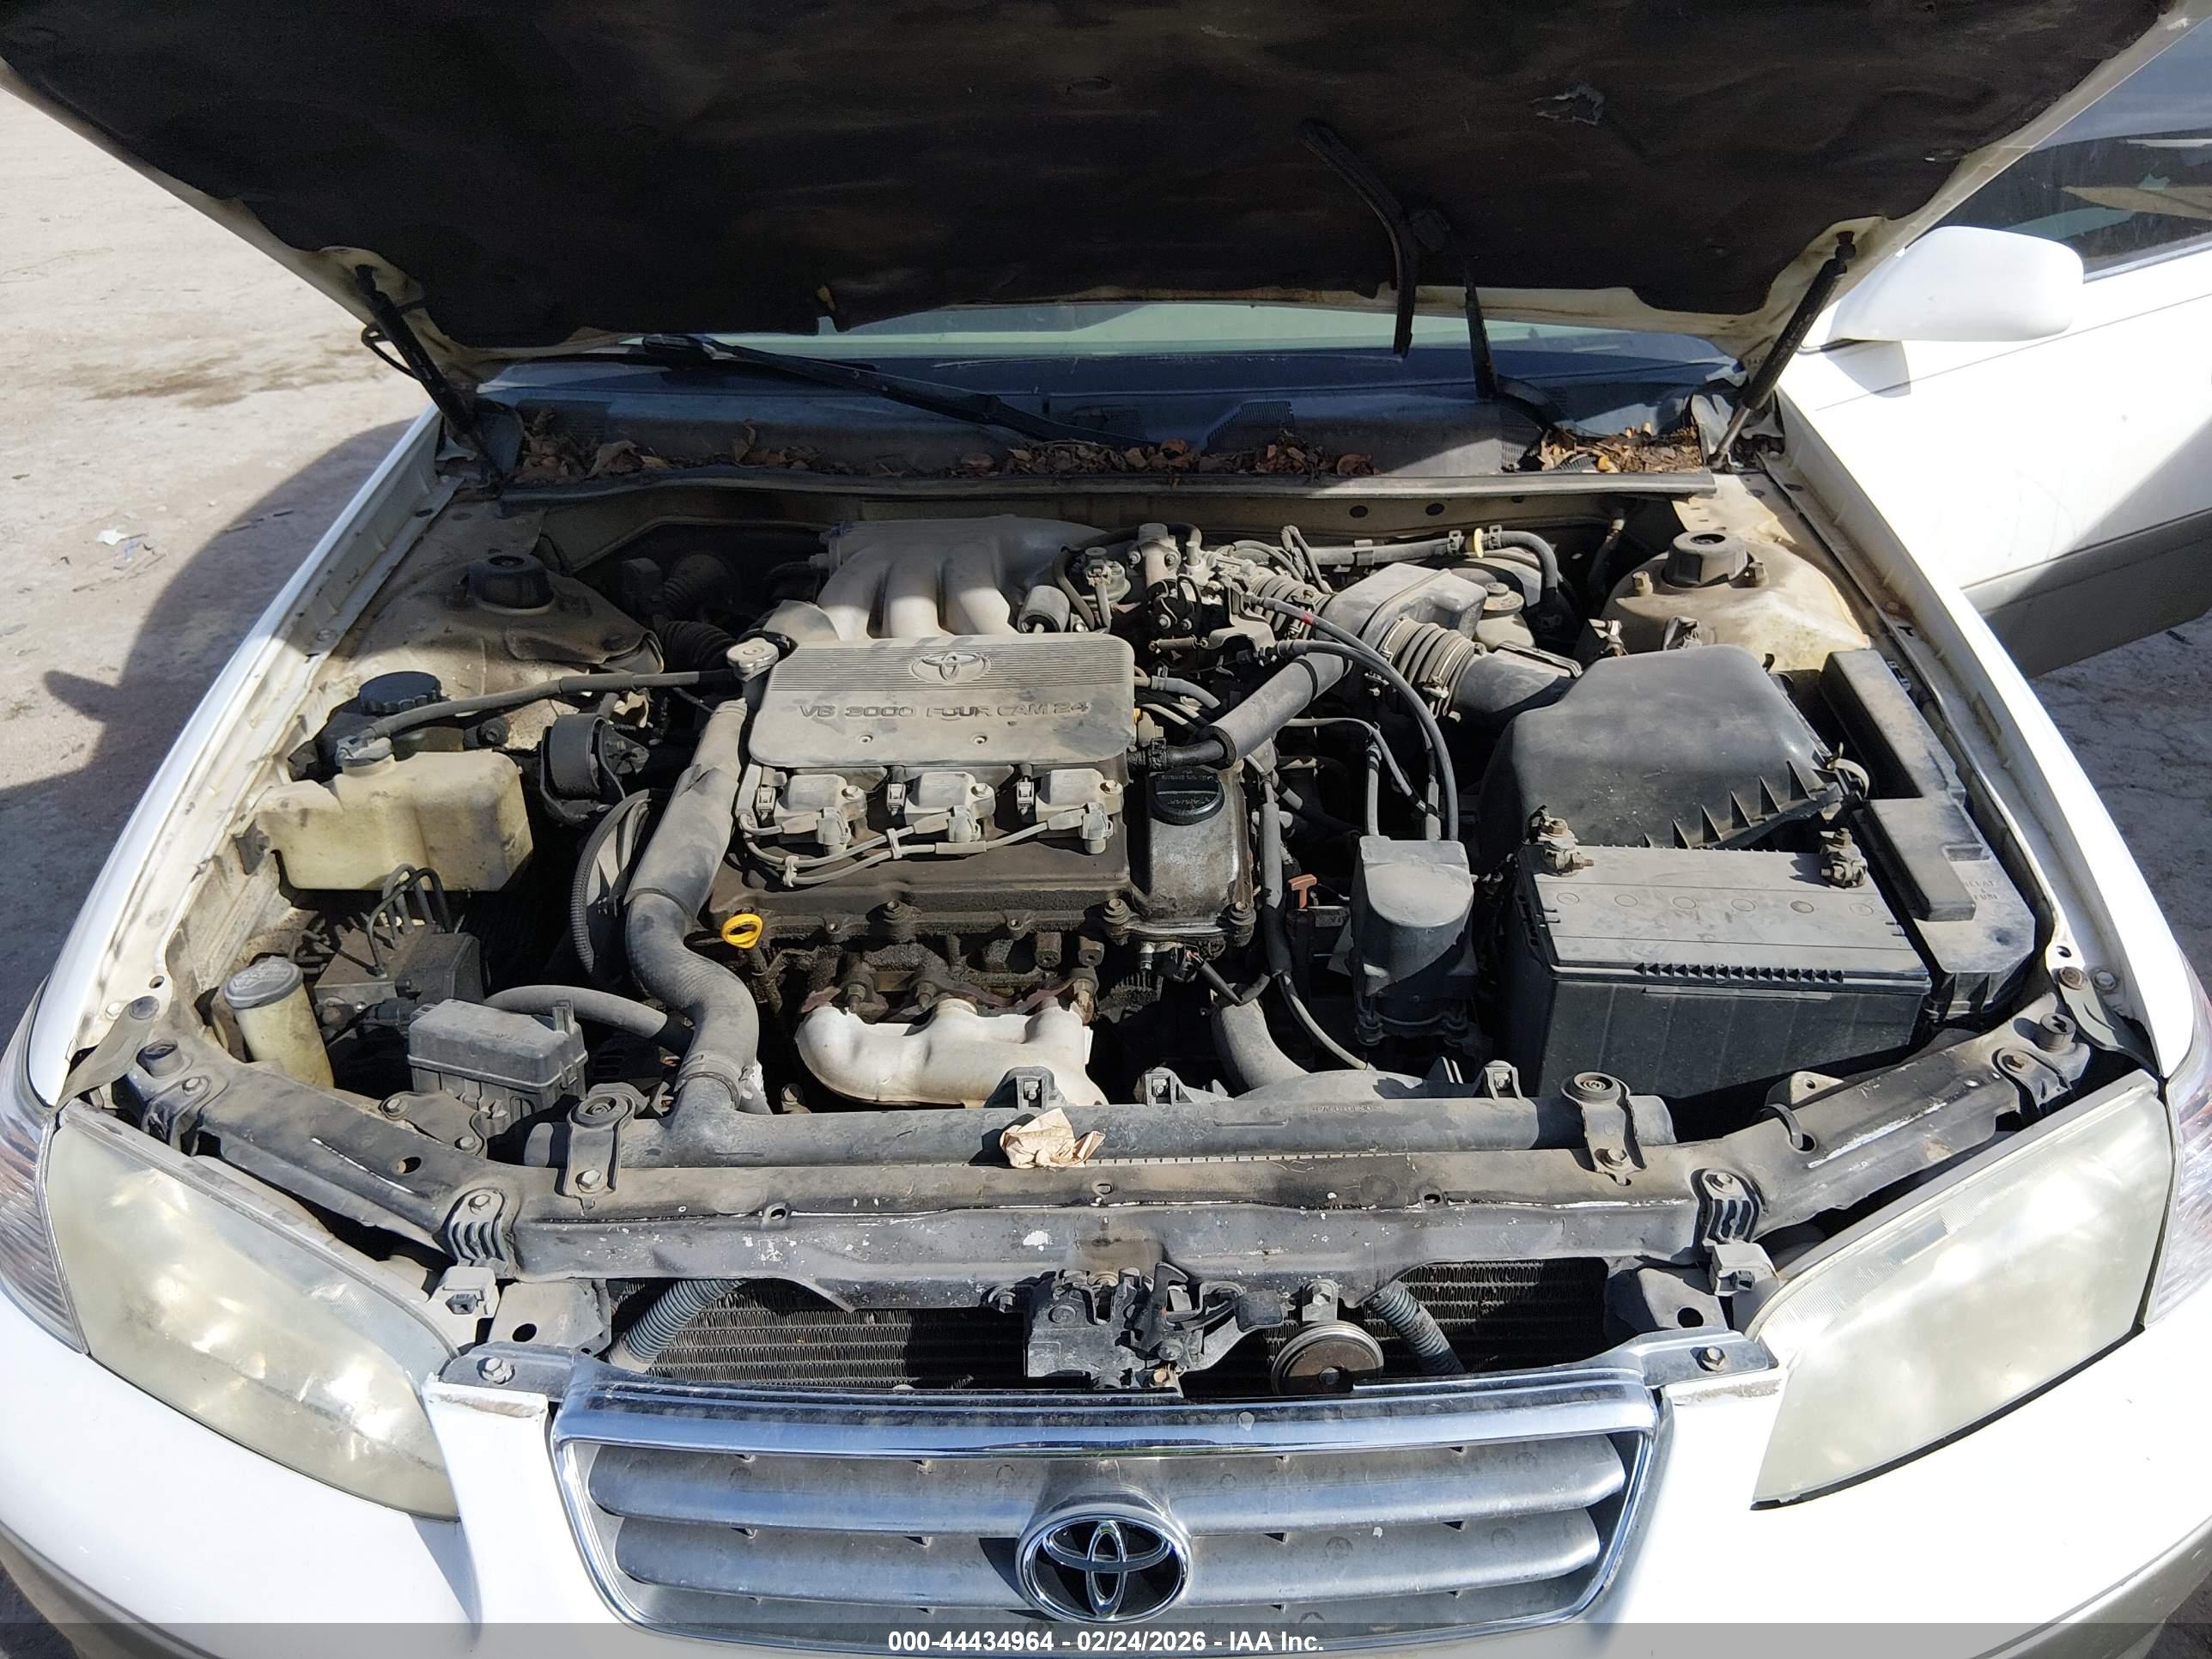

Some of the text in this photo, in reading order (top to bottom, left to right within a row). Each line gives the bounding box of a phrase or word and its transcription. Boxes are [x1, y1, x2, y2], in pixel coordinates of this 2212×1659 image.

[799, 700, 1089, 718] V6 3000 FOUR CAM 24
